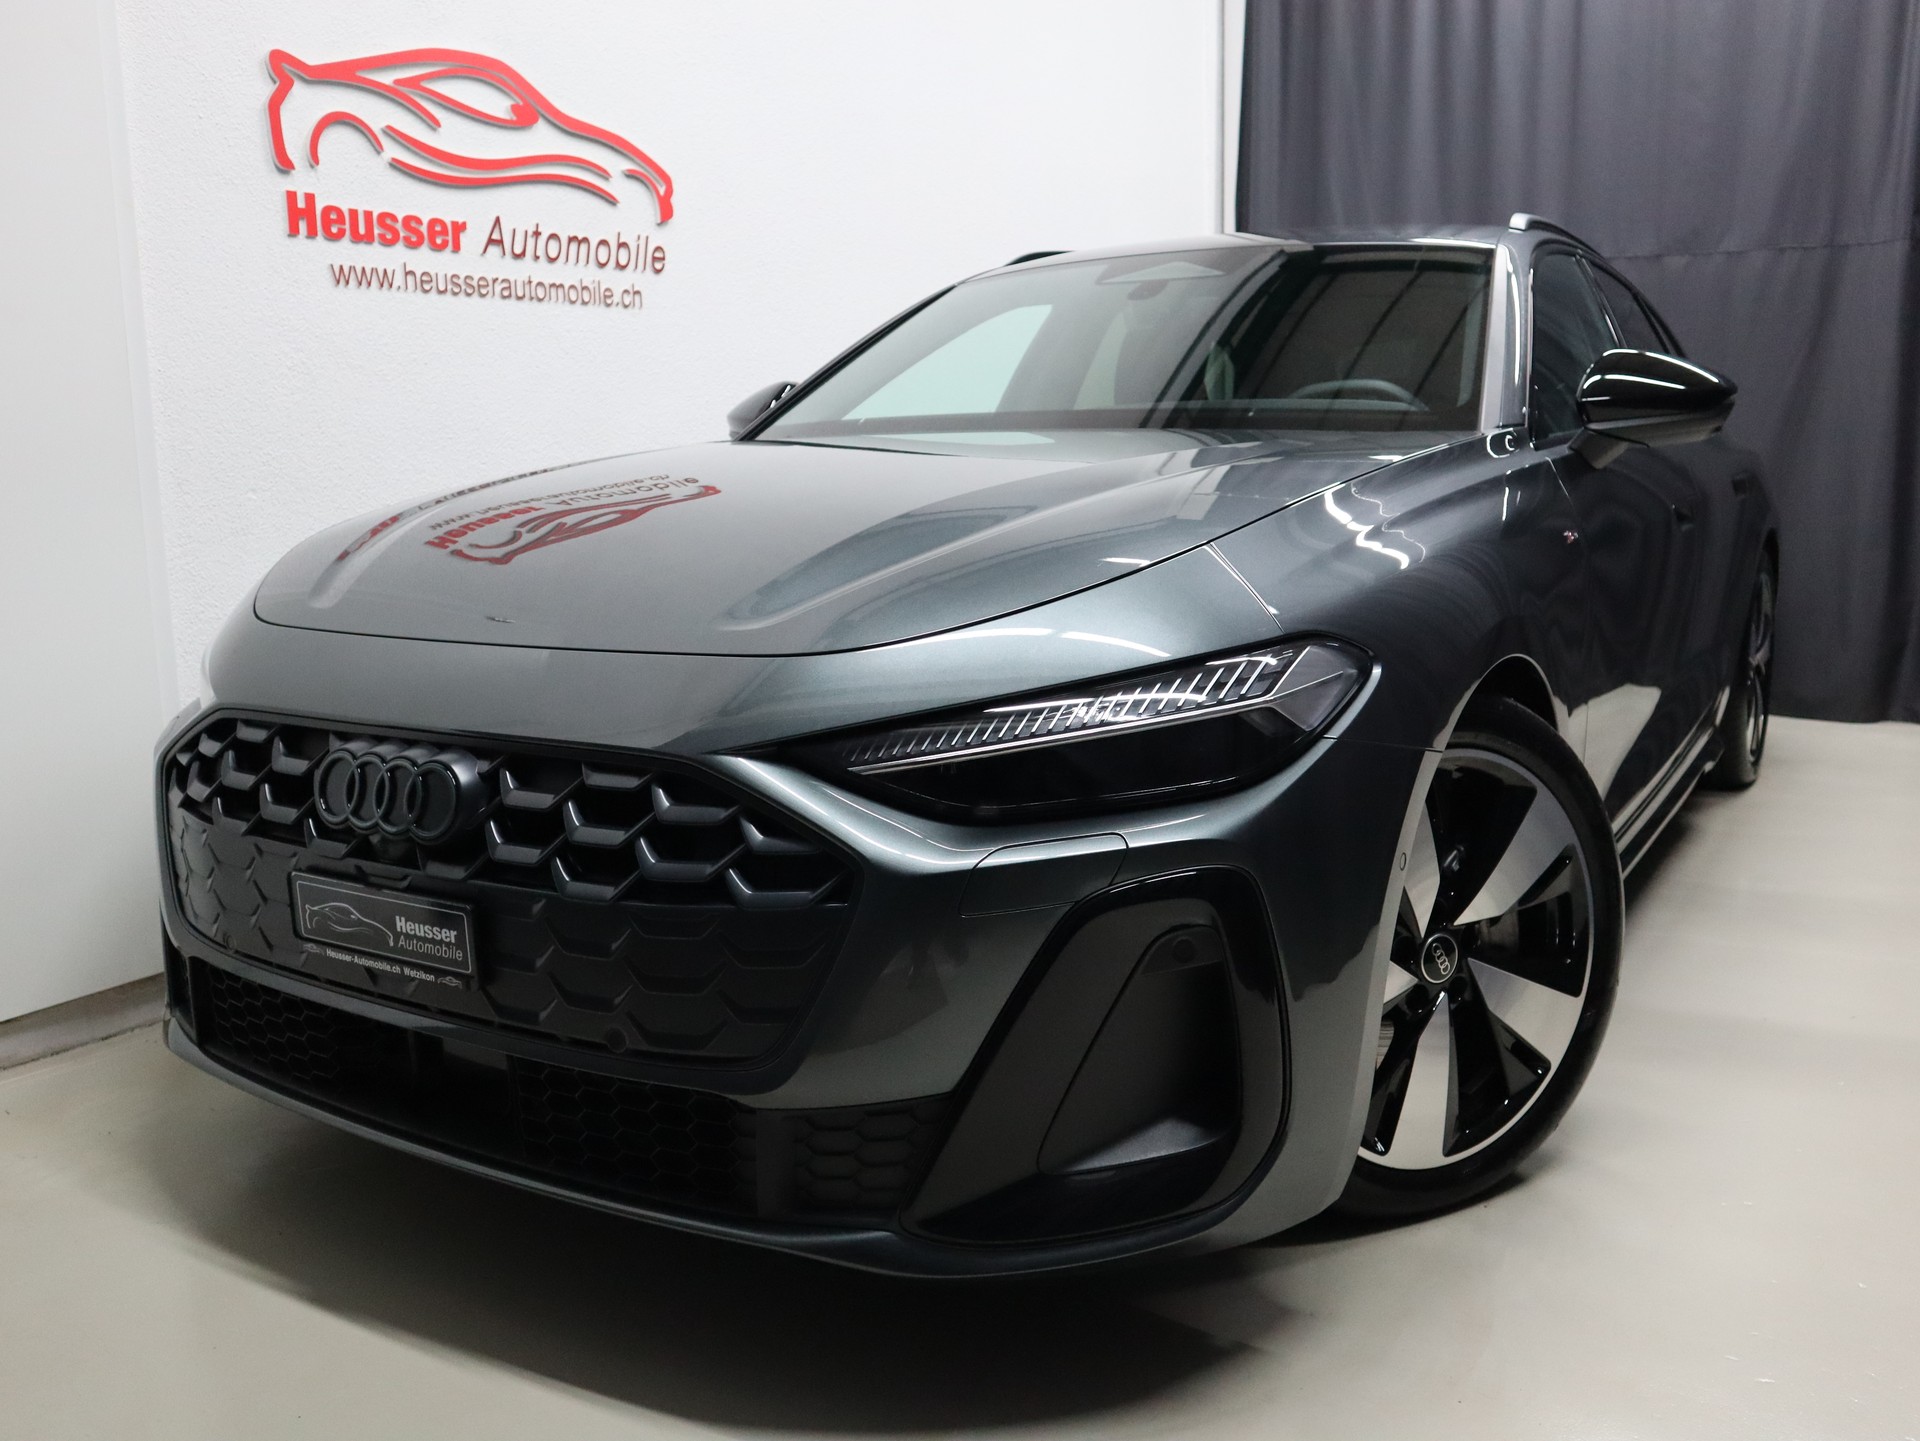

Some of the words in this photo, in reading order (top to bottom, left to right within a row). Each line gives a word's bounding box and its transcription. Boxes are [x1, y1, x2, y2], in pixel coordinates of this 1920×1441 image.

[285, 189, 466, 253] Heusser
[482, 215, 667, 274] Automobile
[330, 262, 643, 309] www.heusserautomobile.ch
[395, 915, 458, 943] Heusser
[326, 948, 401, 974] Heusser-Automobile.ch
[403, 967, 435, 982] Wetzikon
[398, 935, 463, 961] Automobile
